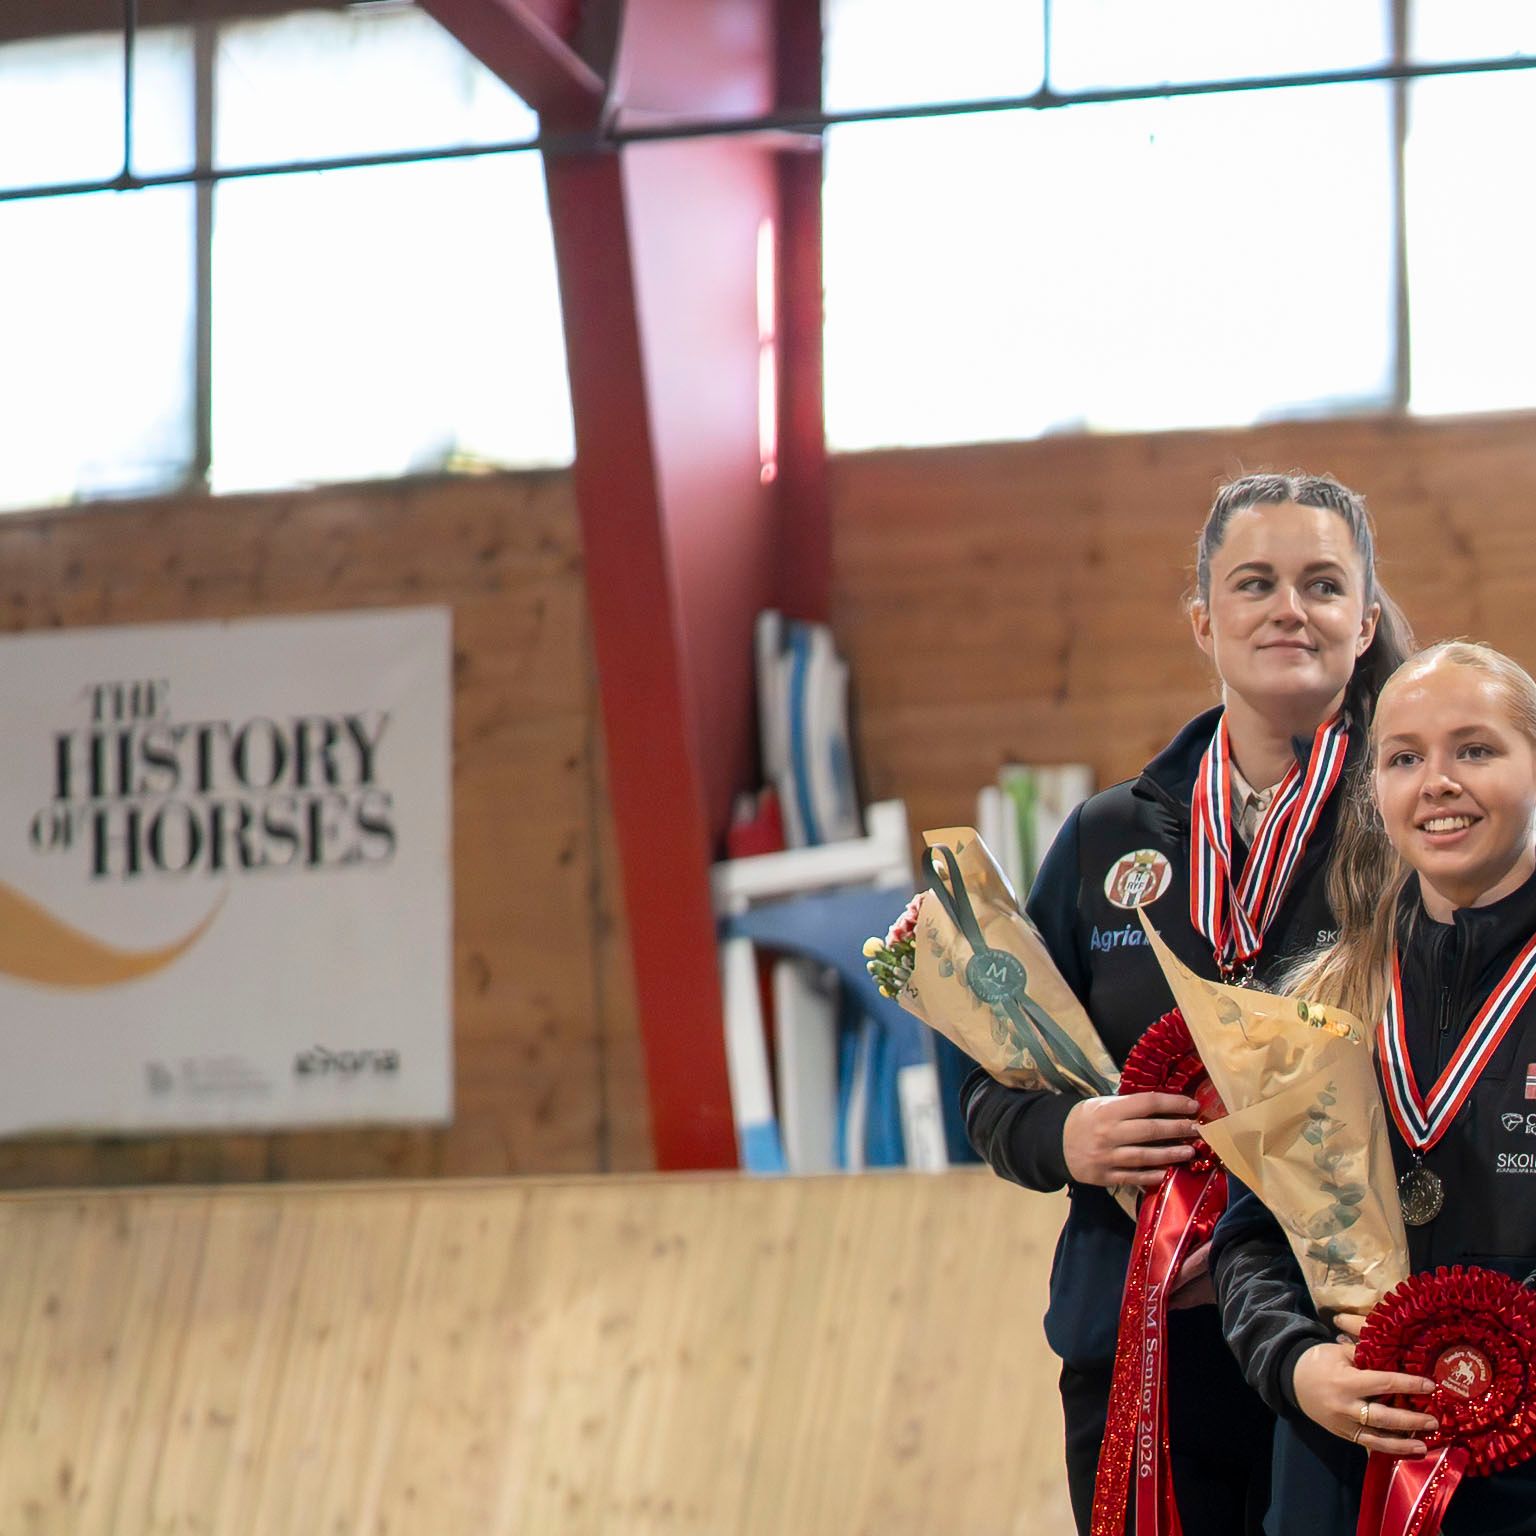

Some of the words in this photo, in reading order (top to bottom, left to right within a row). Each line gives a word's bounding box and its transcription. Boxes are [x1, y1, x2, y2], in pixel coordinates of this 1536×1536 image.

[88, 680, 169, 723] THE
[52, 711, 390, 803] HISTORY
[29, 804, 89, 855] OF
[84, 793, 398, 880] HORSES
[1090, 923, 1143, 952] Agria
[986, 962, 1007, 982] M
[1144, 1283, 1161, 1327] NM
[1140, 1337, 1159, 1413] Senior
[1139, 1420, 1156, 1479] 2026
